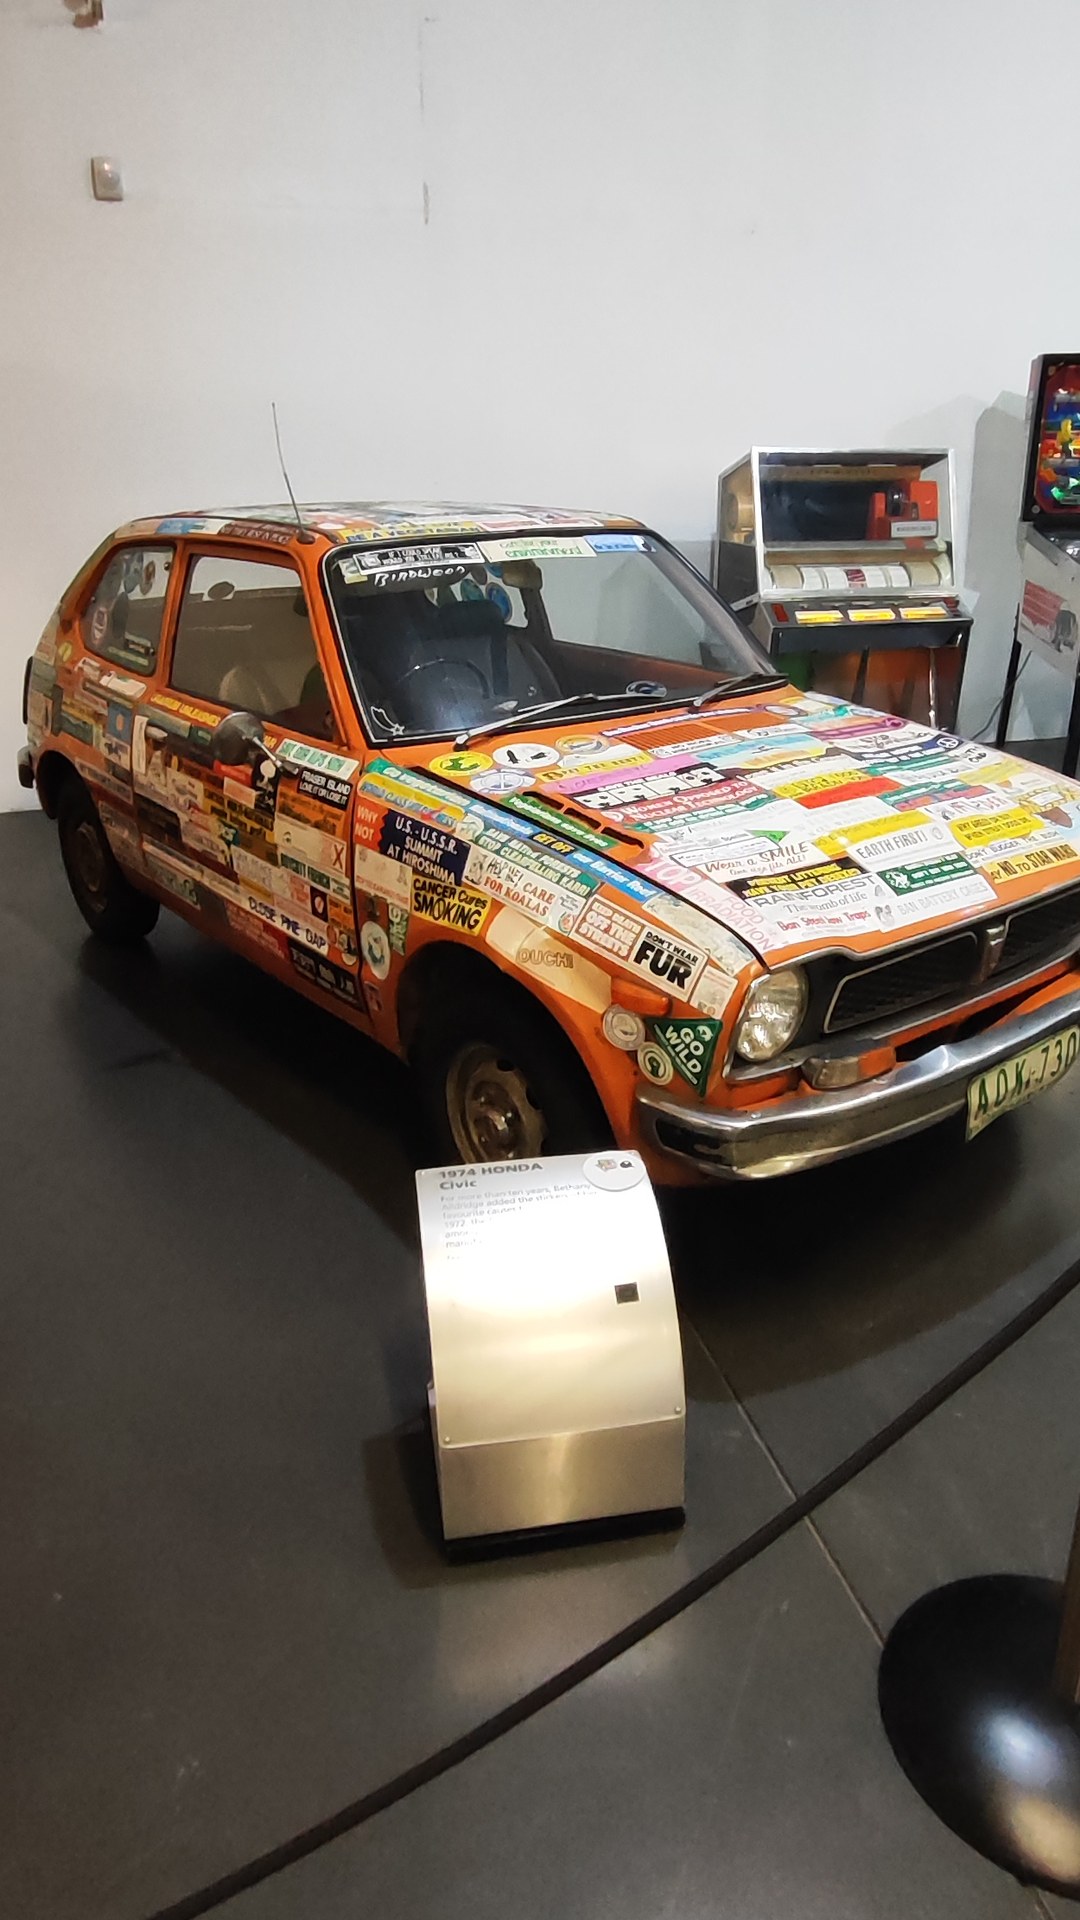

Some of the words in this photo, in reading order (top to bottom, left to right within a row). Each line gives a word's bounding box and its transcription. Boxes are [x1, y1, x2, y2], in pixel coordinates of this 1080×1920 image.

[302, 770, 326, 787] FRASER
[326, 779, 351, 796] ISLAND
[357, 805, 379, 824] WHY
[355, 822, 375, 842] NOT
[395, 815, 413, 835] U.S.
[420, 826, 458, 855] U.S.S.R.
[855, 838, 895, 860] EARTH
[894, 830, 928, 849] FIRST!
[404, 835, 443, 864] SUMMIT
[703, 860, 743, 873] Wear
[747, 858, 758, 866] a
[758, 840, 810, 863] SMILE
[997, 860, 1018, 877] NO
[1015, 861, 1031, 873] TO
[1025, 850, 1055, 870] STAR
[1046, 843, 1079, 862] WARS
[387, 843, 400, 858] AT
[402, 850, 456, 887] HIROSHIMA
[413, 878, 457, 900] CANCER
[457, 889, 488, 910] Cures
[483, 875, 504, 895] FOR
[503, 886, 549, 917] KOALAS
[522, 881, 556, 906] CARE
[751, 874, 877, 907] RAINFOREST
[848, 890, 868, 904] life
[413, 891, 482, 930] SMOKING
[688, 888, 775, 951] IRRADIATION
[725, 895, 764, 924] FOOD
[896, 901, 919, 916] BAN
[645, 930, 673, 950] DON'T
[672, 945, 699, 965] WEAR
[633, 939, 692, 990] FUR
[665, 1024, 702, 1074] WILD
[680, 1027, 704, 1056] GO
[439, 1168, 477, 1180] 1974
[481, 1162, 543, 1176] HONDA
[439, 1180, 478, 1191] Civic
[484, 1190, 506, 1199] than
[507, 1188, 524, 1197] ten
[486, 1197, 517, 1206] added
[518, 1195, 534, 1204] the
